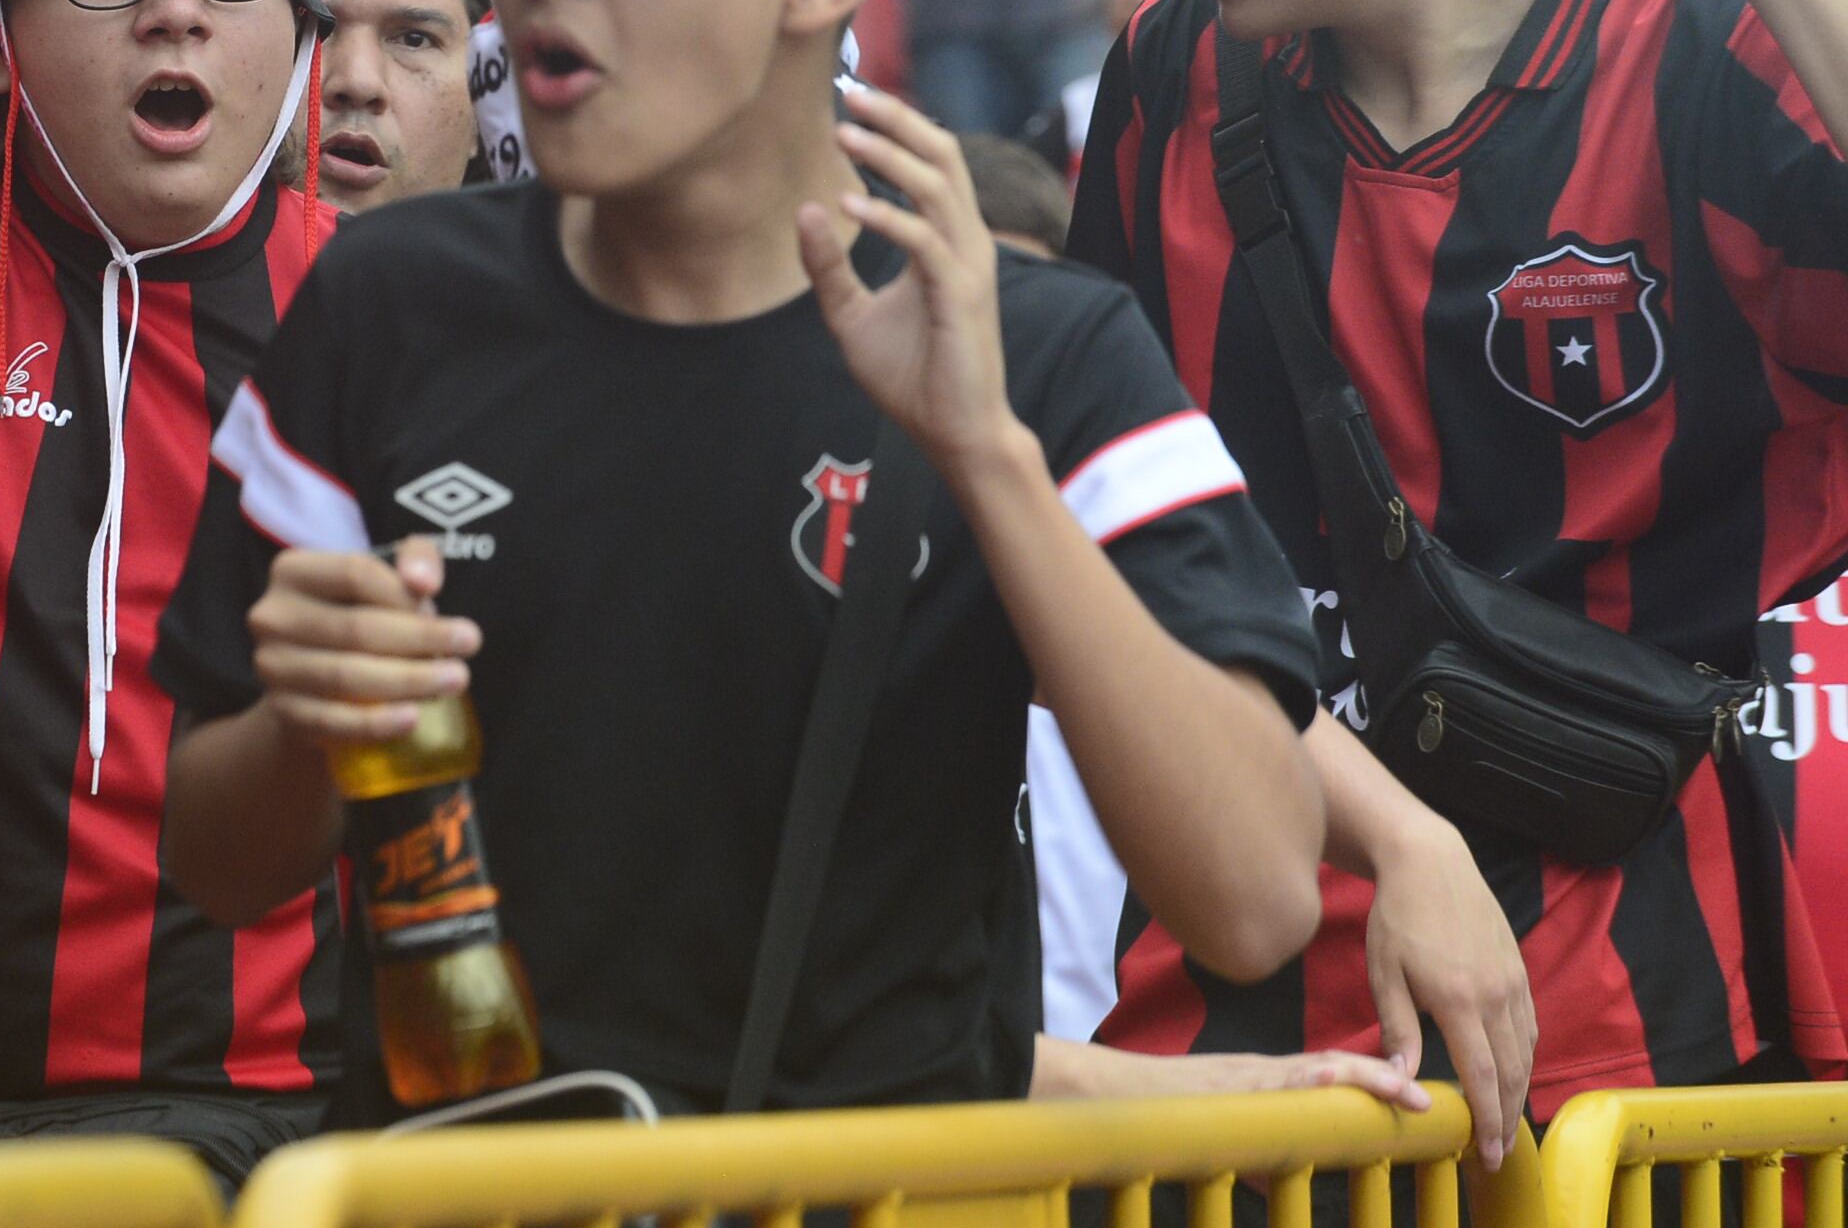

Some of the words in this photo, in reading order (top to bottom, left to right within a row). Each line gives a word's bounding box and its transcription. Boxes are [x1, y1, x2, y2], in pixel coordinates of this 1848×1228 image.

[1512, 275, 1544, 288] LIGA
[1548, 272, 1628, 288] DEPORTIVA
[1522, 292, 1619, 308] ALAJUELENSE
